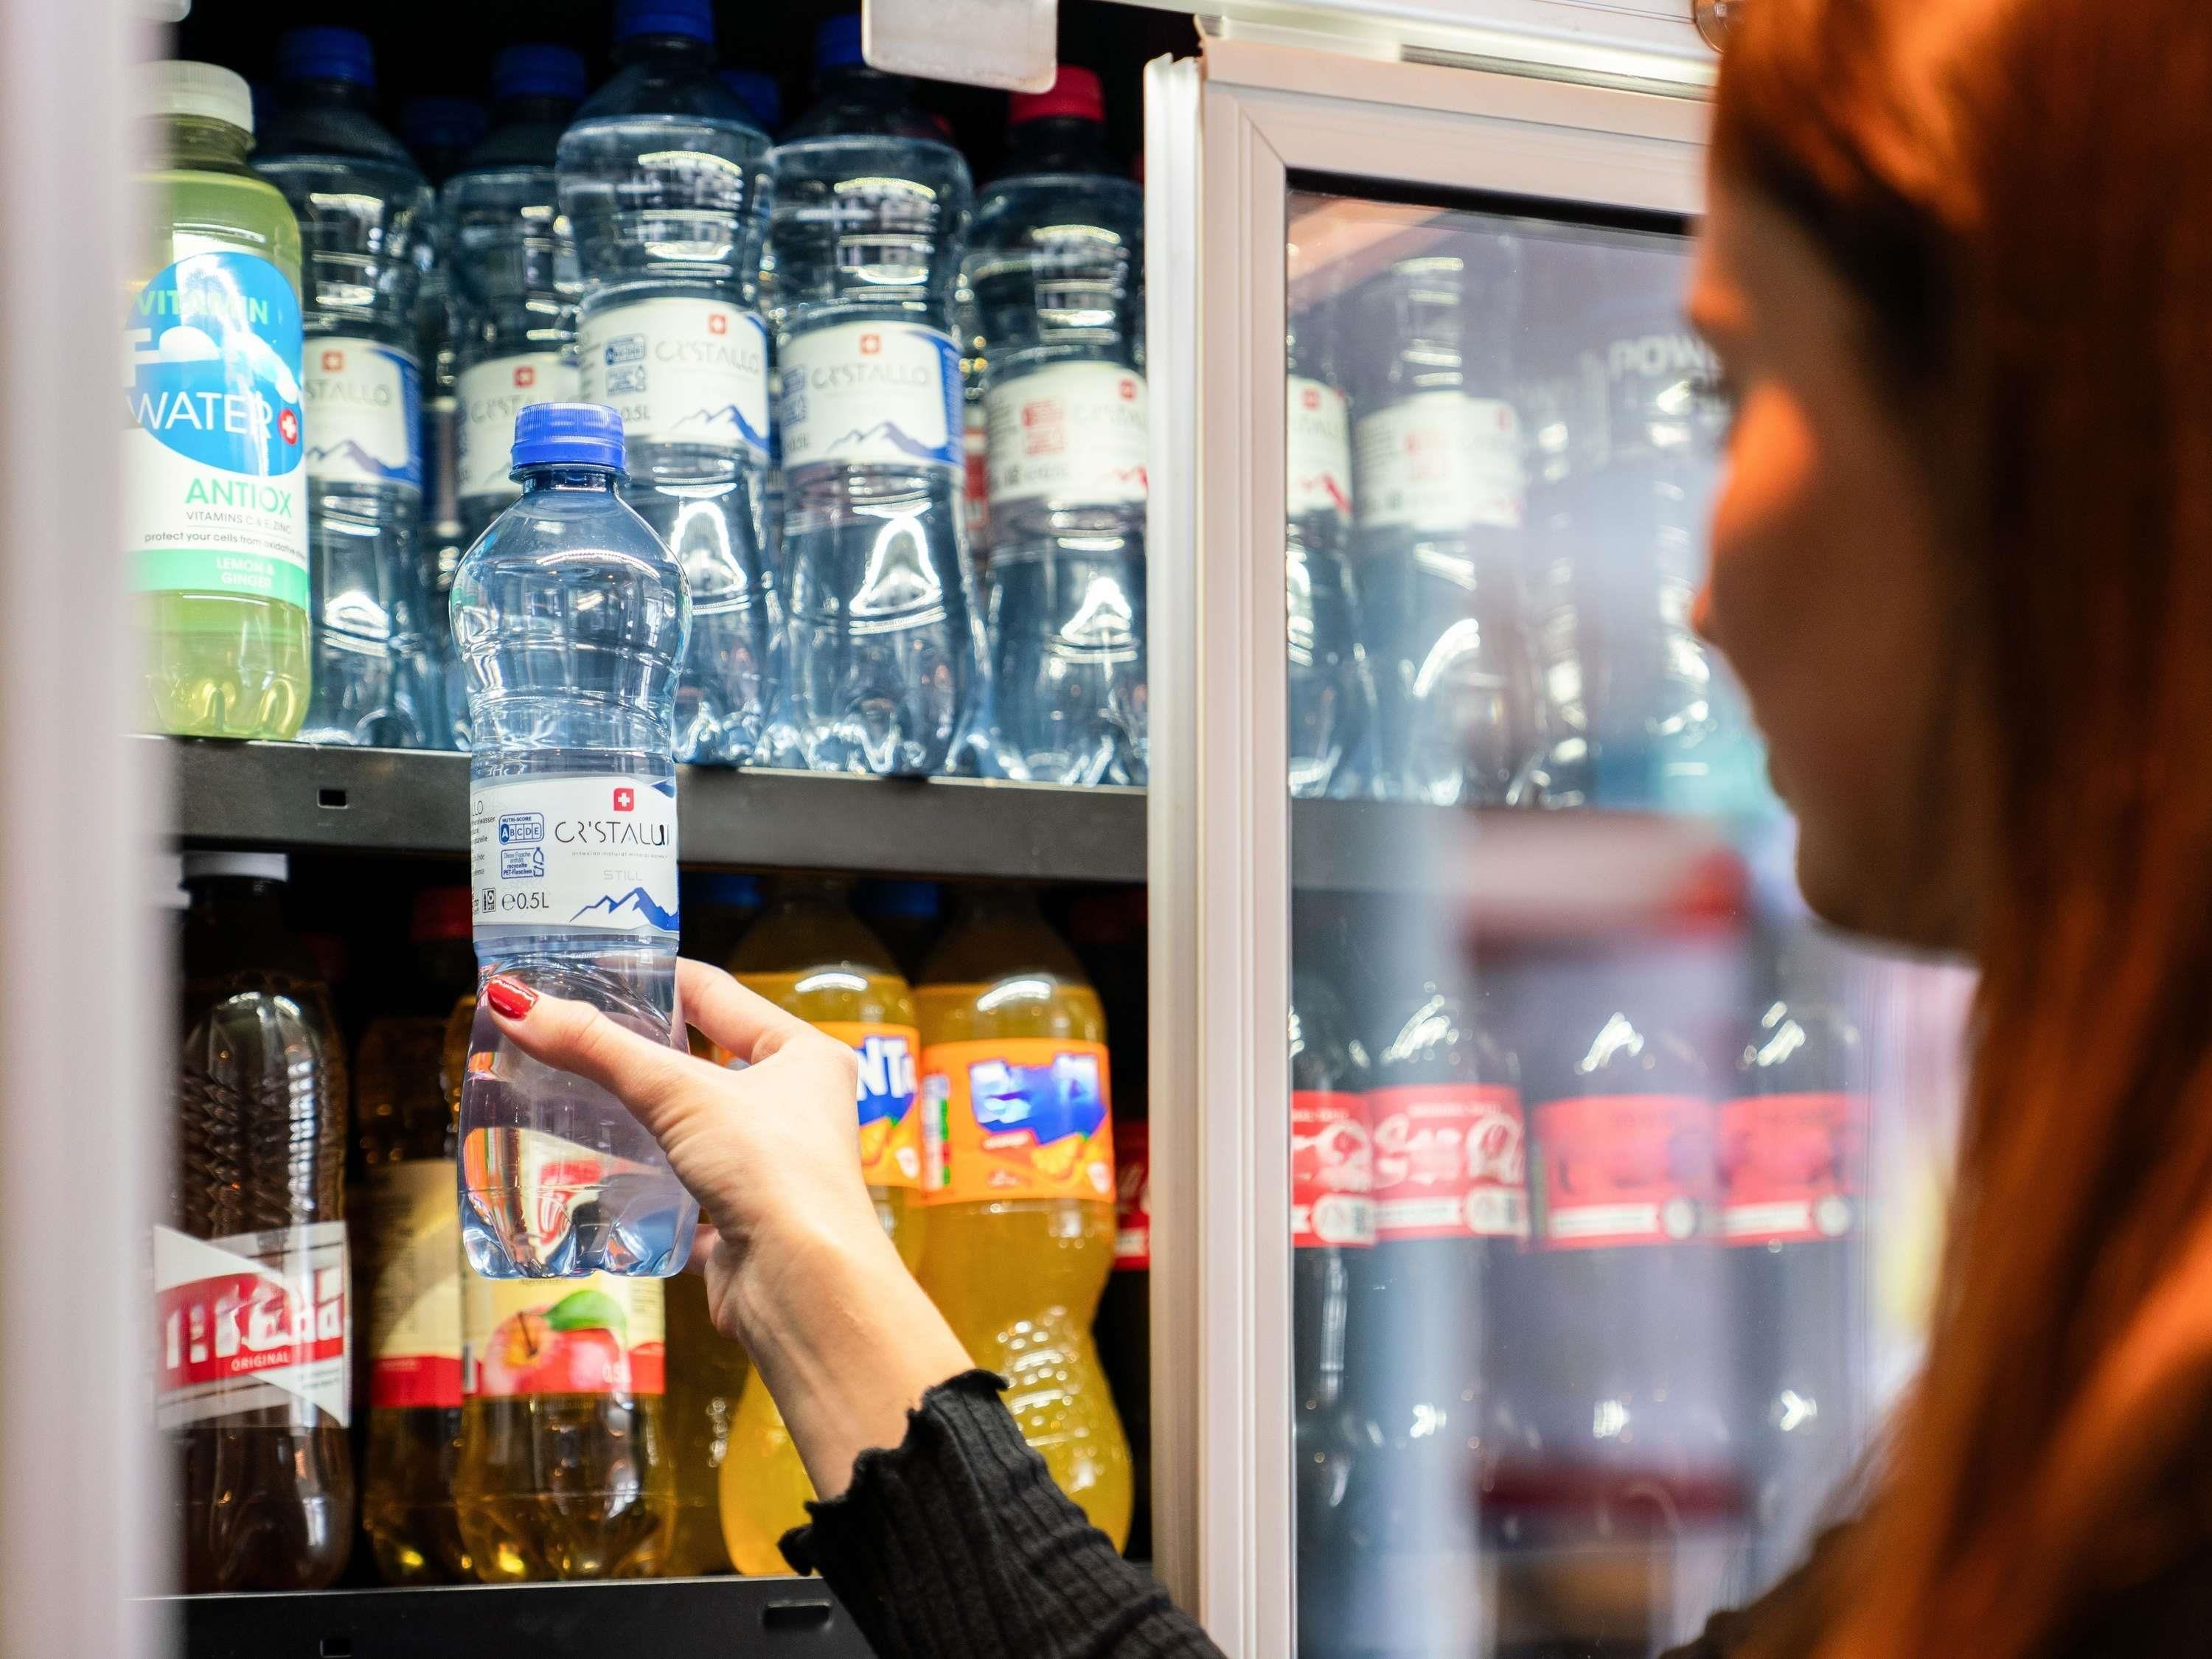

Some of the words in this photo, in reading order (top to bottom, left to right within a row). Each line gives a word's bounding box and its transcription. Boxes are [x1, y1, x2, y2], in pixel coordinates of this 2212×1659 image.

[126, 391, 273, 440] WATER
[184, 478, 293, 518] ANTIOX
[186, 511, 243, 524] VITAMINS
[145, 532, 184, 543] protect
[187, 533, 211, 542] your
[213, 534, 238, 543] cells
[240, 535, 262, 546] from
[603, 869, 643, 881] STILL
[232, 1352, 290, 1371] ORIGINAL
